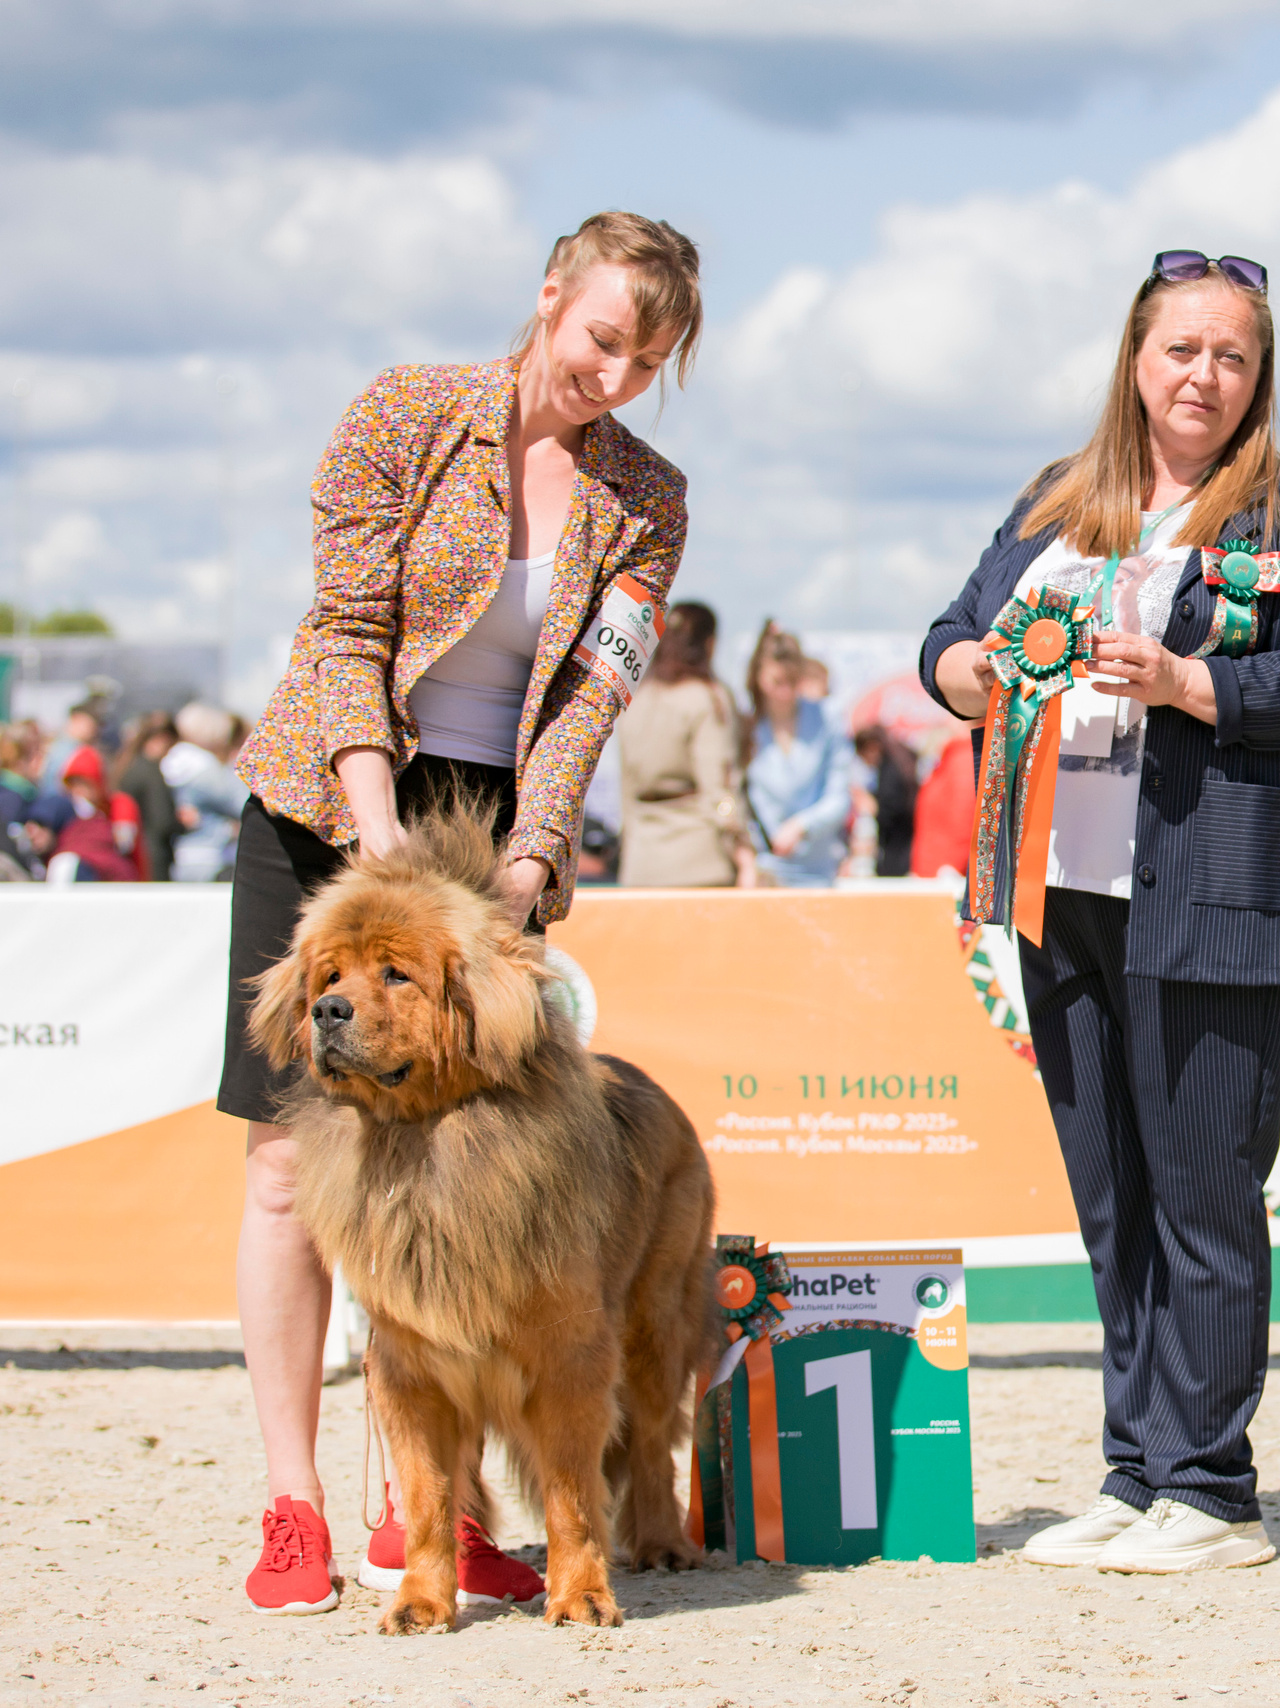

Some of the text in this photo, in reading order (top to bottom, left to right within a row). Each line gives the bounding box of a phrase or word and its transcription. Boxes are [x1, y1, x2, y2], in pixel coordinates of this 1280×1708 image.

[627, 612, 650, 641] РОССИЯ
[597, 627, 642, 681] 0986
[589, 655, 629, 698] 10.06.2023
[721, 1074, 758, 1099] 10
[798, 1074, 828, 1099] 11
[840, 1074, 959, 1099] ИЮНЯ
[836, 1303, 877, 1311] РАЦИОНЫ
[925, 1327, 937, 1336] 10
[946, 1327, 956, 1336] 11
[926, 1338, 957, 1347] ИЮНЯ
[804, 1349, 877, 1529] 1
